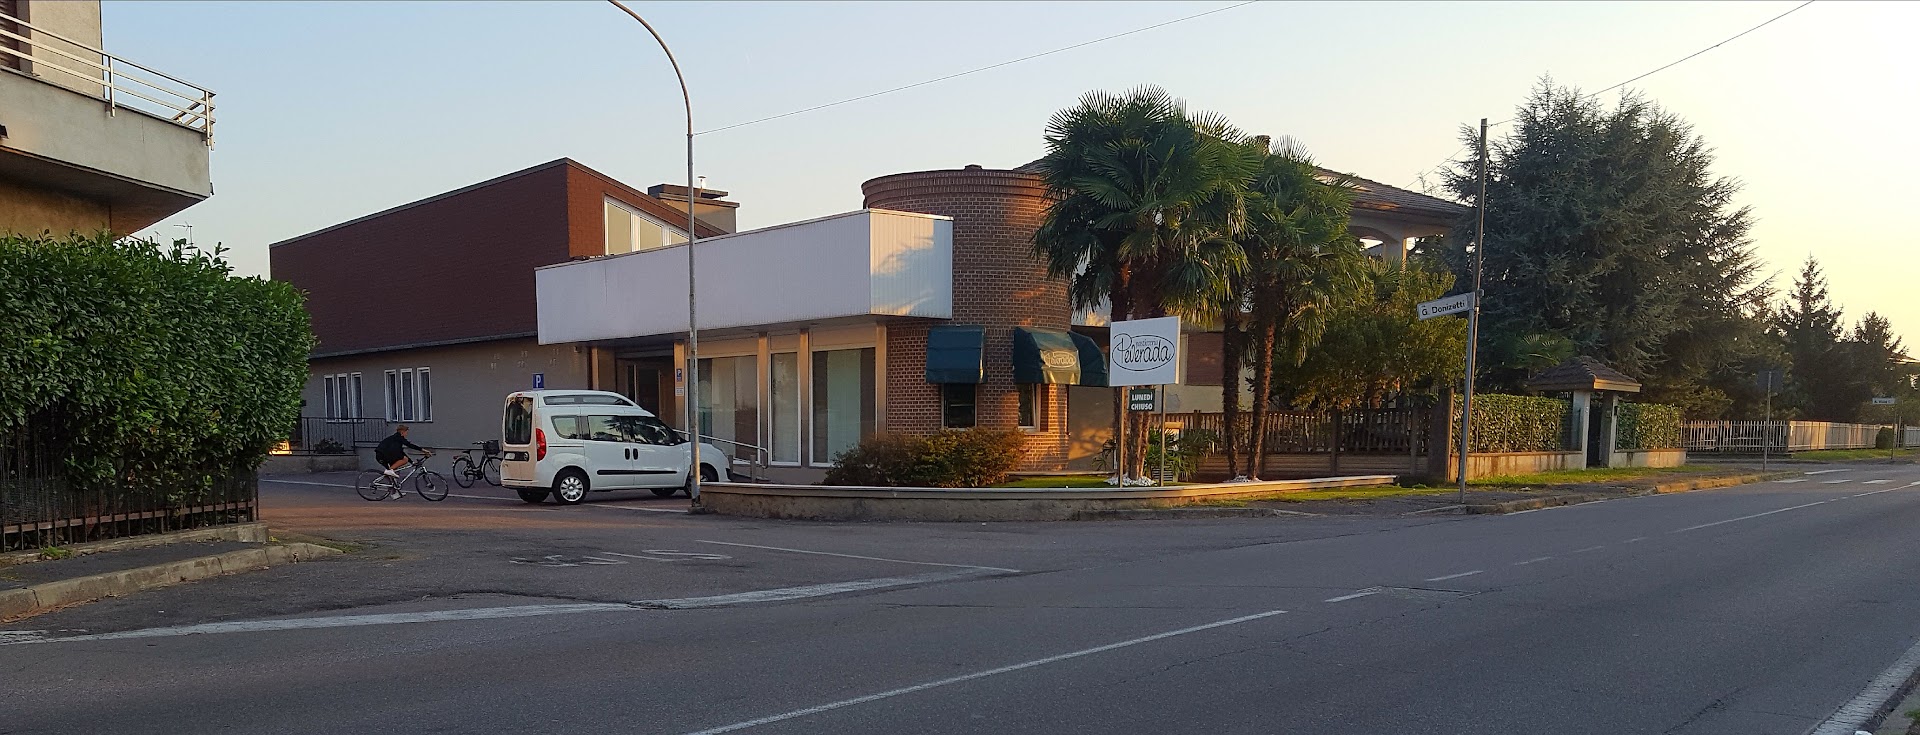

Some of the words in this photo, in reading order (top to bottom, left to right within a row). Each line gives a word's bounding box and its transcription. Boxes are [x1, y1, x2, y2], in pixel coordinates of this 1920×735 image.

[1431, 300, 1465, 314] Donizetti
[1113, 333, 1171, 364] Peverada
[535, 374, 542, 388] P
[1131, 391, 1153, 401] LUNEDÌ
[1131, 402, 1153, 411] CHIUSO
